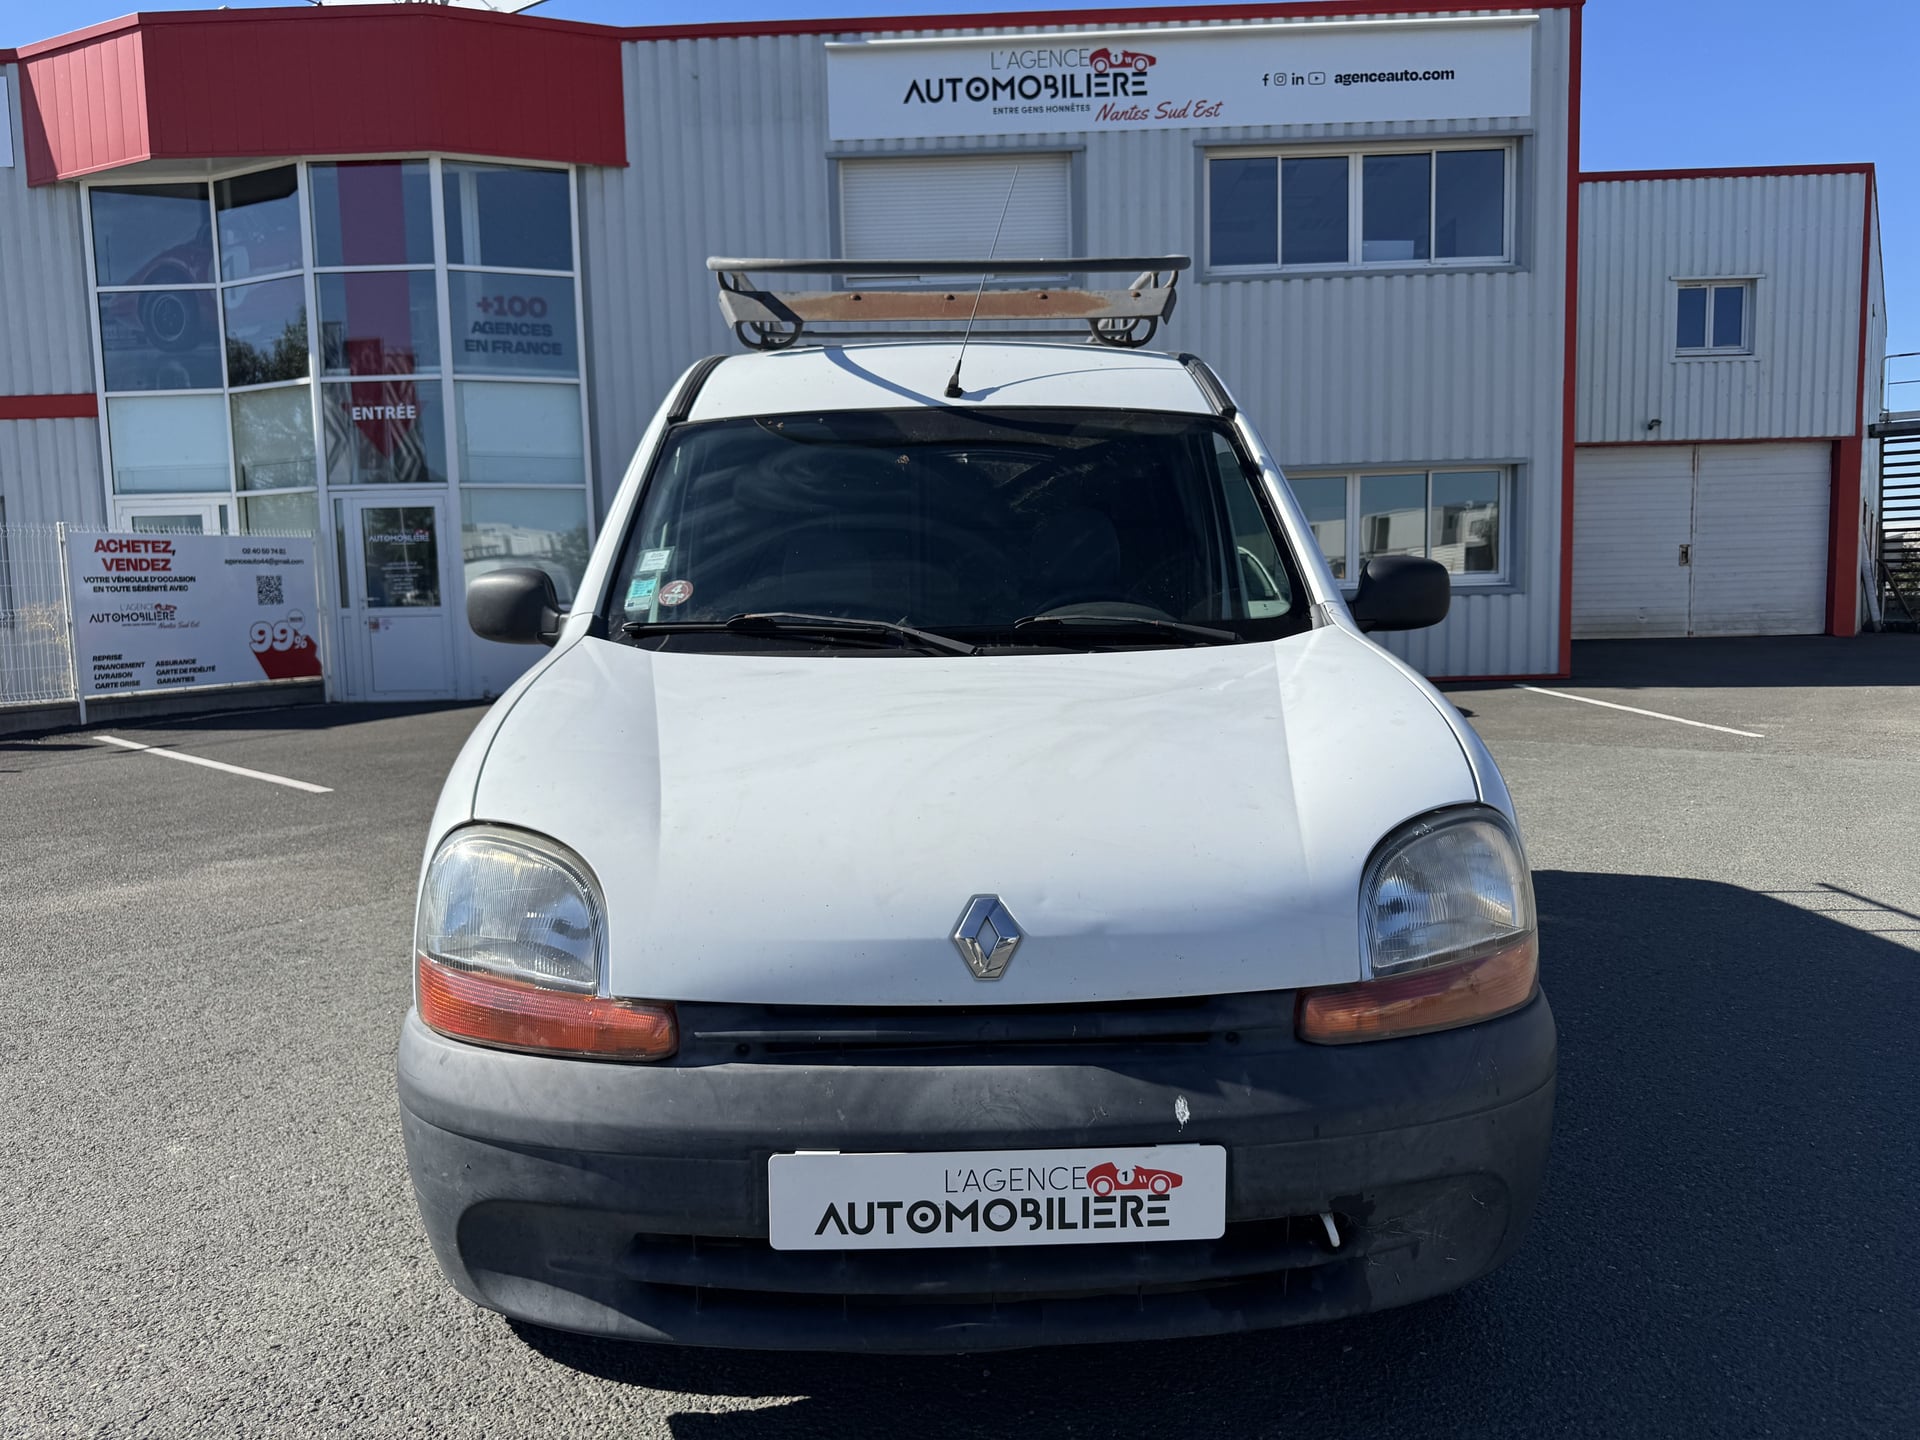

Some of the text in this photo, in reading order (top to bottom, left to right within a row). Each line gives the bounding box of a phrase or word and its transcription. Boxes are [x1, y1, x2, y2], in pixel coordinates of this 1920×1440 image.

[990, 48, 1089, 70] L'AGENCE
[1334, 69, 1455, 86] agenceauto.com
[993, 103, 1091, 115] ENTRE GENS HONNÊTES
[1095, 99, 1224, 122] Nantes Sud Est
[476, 295, 548, 318] +100
[471, 321, 553, 337] AGENCES
[464, 339, 563, 356] EN FRANCE
[352, 403, 416, 420] ENTRÉE
[94, 539, 176, 556] ACHETEZ,
[102, 557, 171, 572] VENDEZ
[83, 574, 196, 584] VOTRE VÉHICULE D'OCCASION
[93, 585, 104, 593] EN
[106, 585, 131, 593] TOUTE
[132, 584, 168, 593] SÉRÉNITÉ
[92, 654, 123, 662] REPRISE
[155, 659, 197, 667] ASSURANCE
[93, 662, 145, 671] FINANCEMENT
[156, 668, 178, 676] CARTE
[94, 671, 133, 680] LIVRAISON
[157, 676, 195, 685] GARANTIES
[95, 680, 140, 690] CARTE GRISE
[945, 1166, 1087, 1193] L'AGENCE
